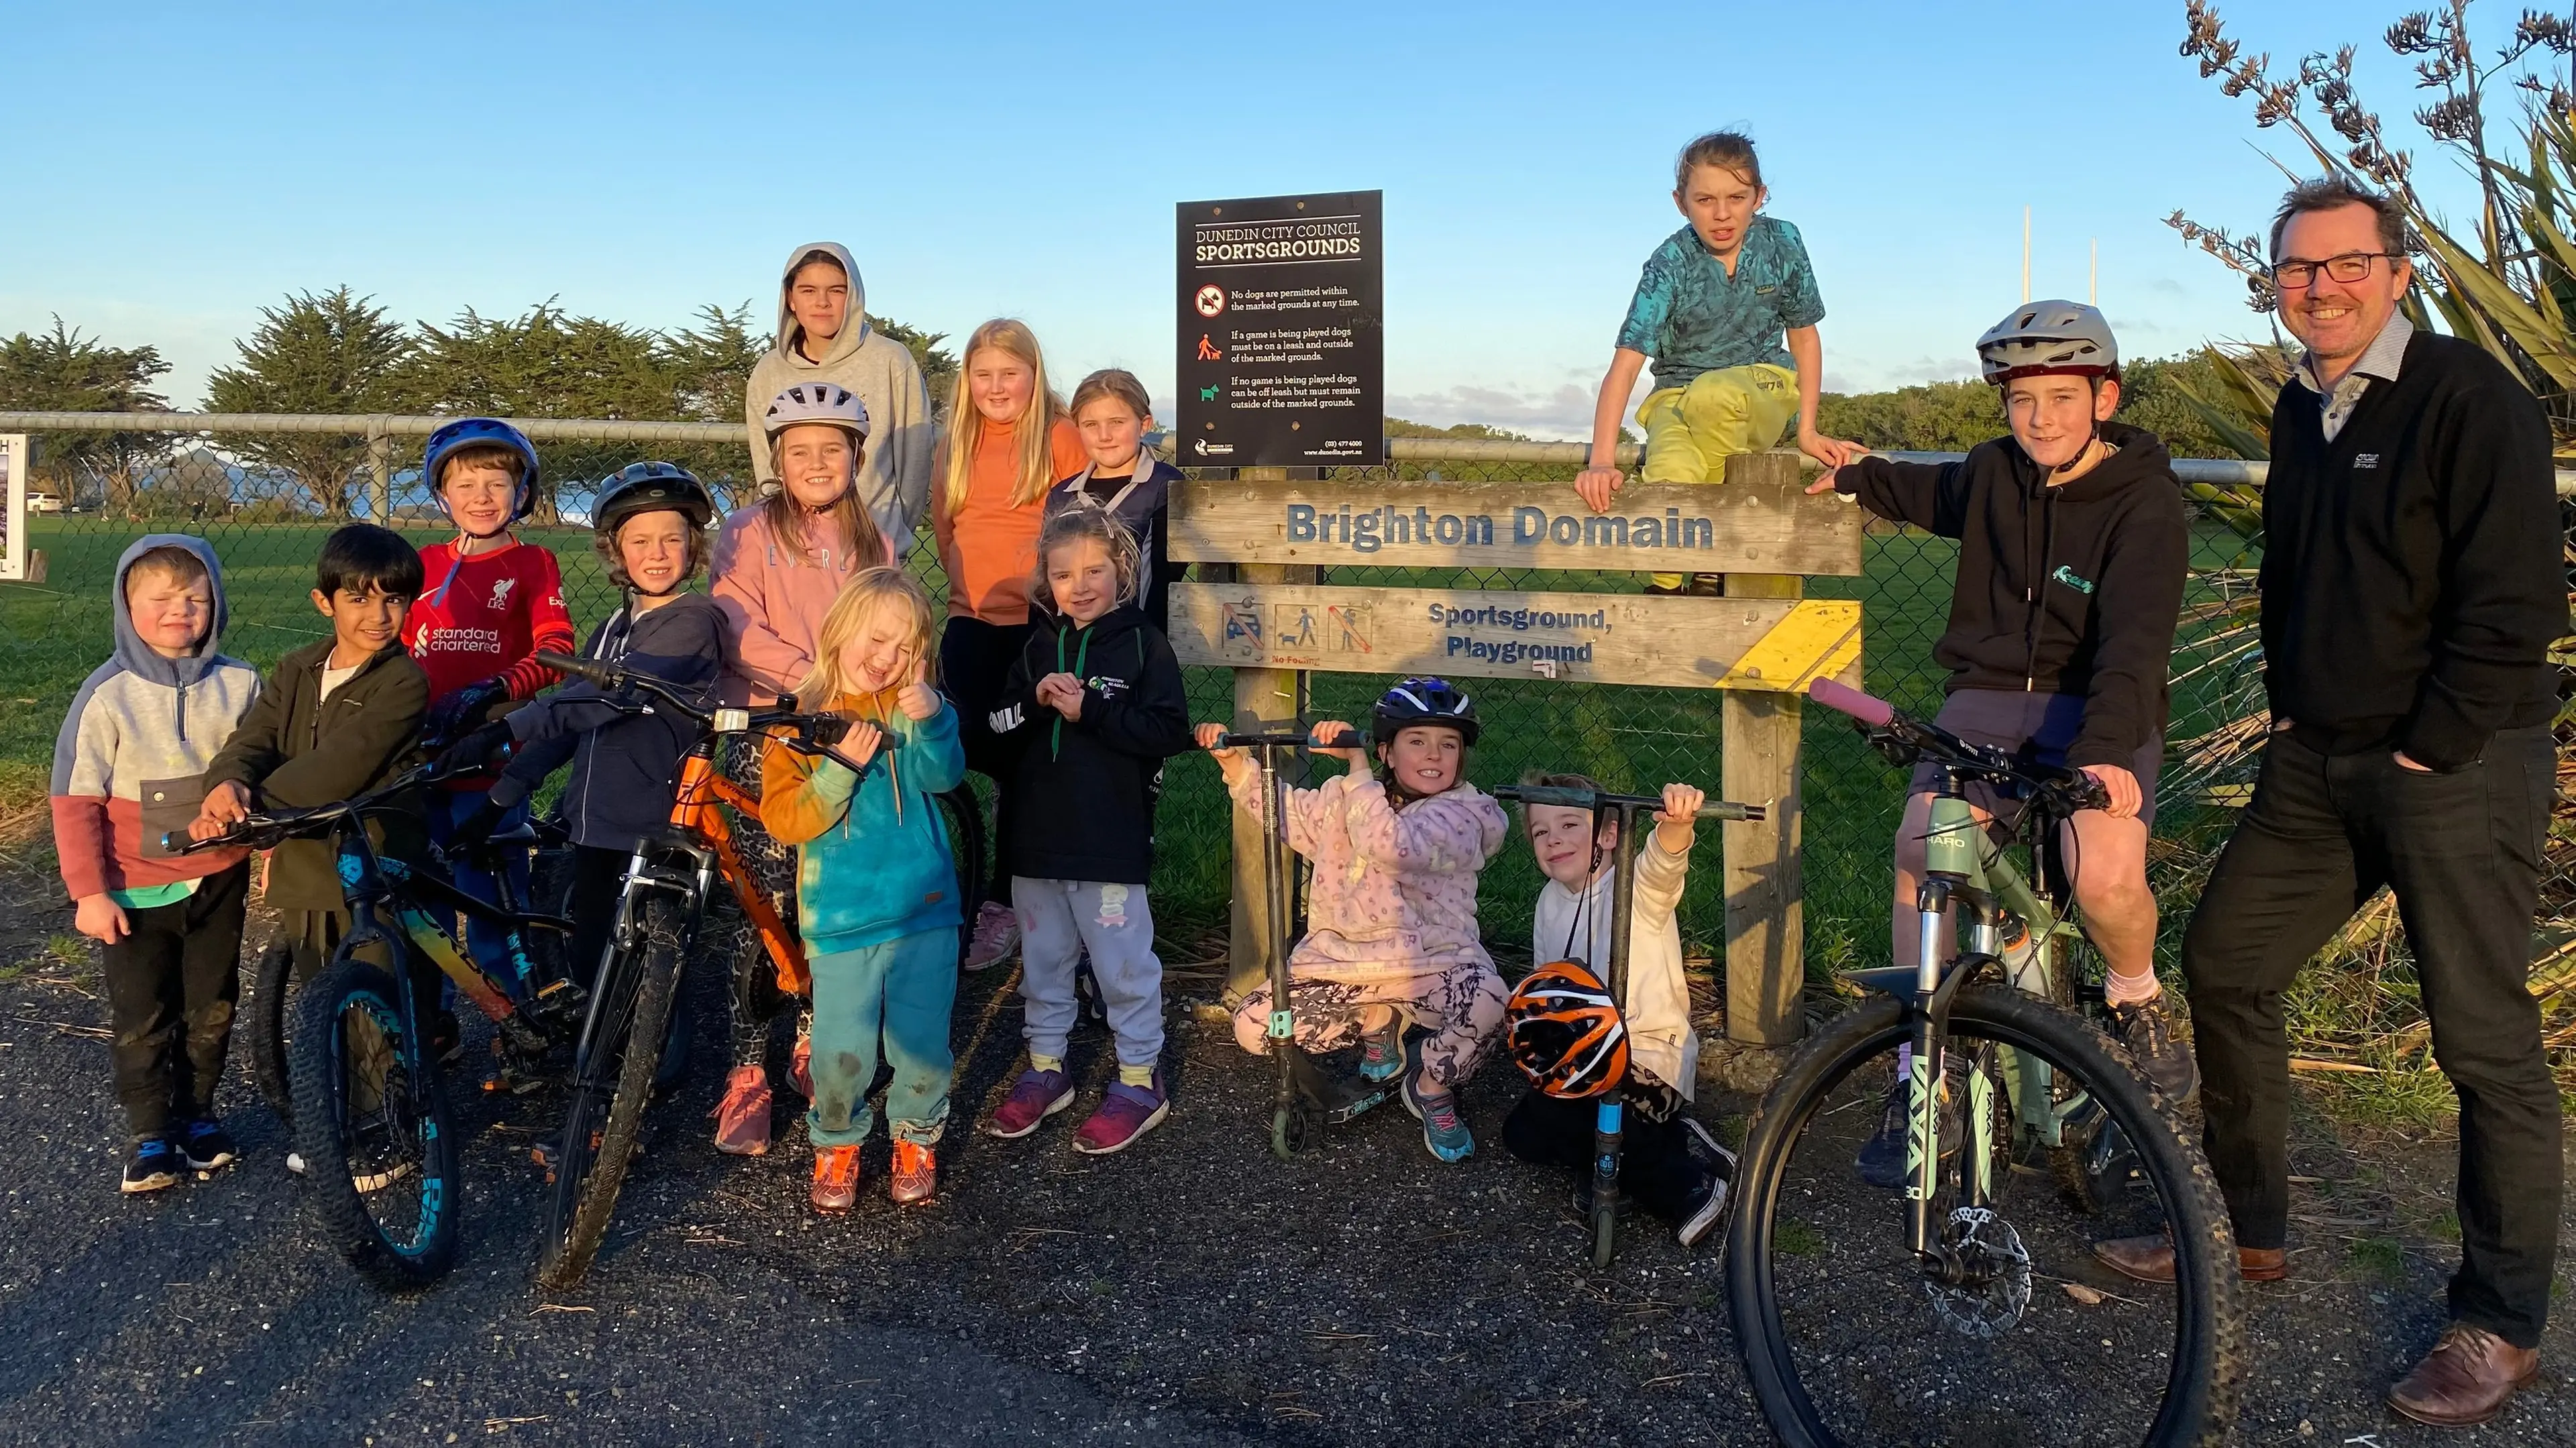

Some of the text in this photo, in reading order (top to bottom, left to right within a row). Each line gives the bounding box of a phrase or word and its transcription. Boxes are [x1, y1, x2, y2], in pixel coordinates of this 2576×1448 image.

[1196, 223, 1360, 242] DUNEDIN CITY COUNCIL
[1196, 237, 1360, 261] SPORTSGROUNDS
[1232, 291, 1243, 299] No
[1245, 290, 1264, 299] dogs
[1280, 286, 1320, 298] permitted
[1322, 286, 1348, 296] within
[1232, 302, 1244, 311] the
[1246, 300, 1276, 310] marked
[1278, 299, 1310, 311] grounds
[1322, 300, 1337, 309] any
[1232, 331, 1238, 339] If
[1246, 333, 1268, 341] game
[1278, 329, 1301, 339] being
[1303, 327, 1330, 338] played
[1332, 327, 1351, 337] dogs
[1253, 341, 1263, 350] be
[1283, 340, 1304, 349] leash
[1306, 339, 1321, 349] and
[1323, 339, 1353, 348] outside
[1231, 351, 1323, 363] of the marked grounds.
[1232, 376, 1238, 385] If
[1251, 378, 1273, 386] game
[1284, 375, 1307, 385] being
[1309, 374, 1336, 385] played
[1337, 374, 1357, 384] dogs
[1247, 388, 1257, 396] be
[1258, 387, 1270, 396] off
[1271, 387, 1292, 396] leash
[1294, 387, 1307, 395] but
[1332, 386, 1360, 394] remain
[1231, 397, 1354, 408] outside of the marked grounds.
[1287, 504, 1713, 553] Brighton Domain
[1428, 603, 1612, 634] Sportsground,
[432, 626, 498, 642] standard
[431, 638, 501, 653] chartered
[1447, 636, 1593, 664] Playground
[1272, 655, 1285, 663] No
[1926, 836, 1966, 848] HARO
